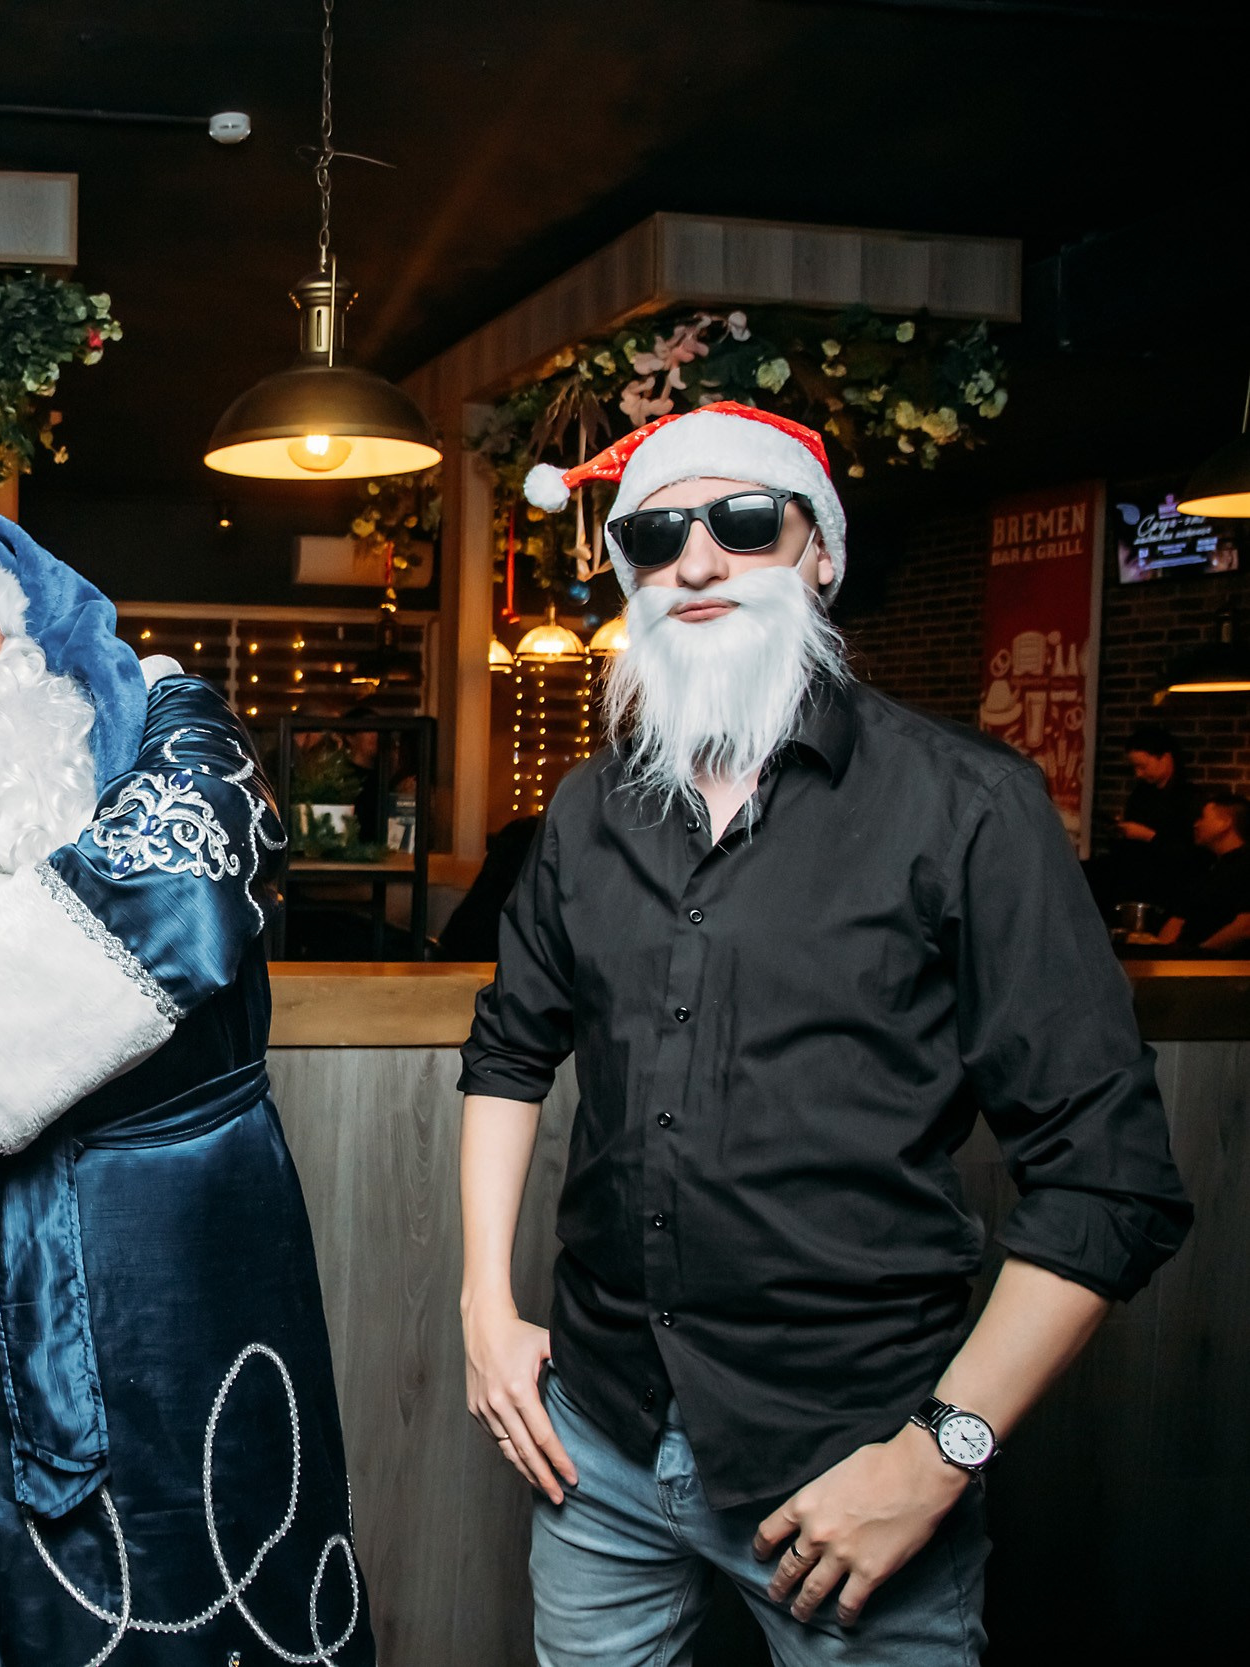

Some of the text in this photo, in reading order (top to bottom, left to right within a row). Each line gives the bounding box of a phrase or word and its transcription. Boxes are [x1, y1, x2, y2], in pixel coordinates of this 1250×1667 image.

[992, 503, 1086, 548] BREMEN
[991, 549, 1019, 567] BAR
[1036, 539, 1083, 559] GRILL
